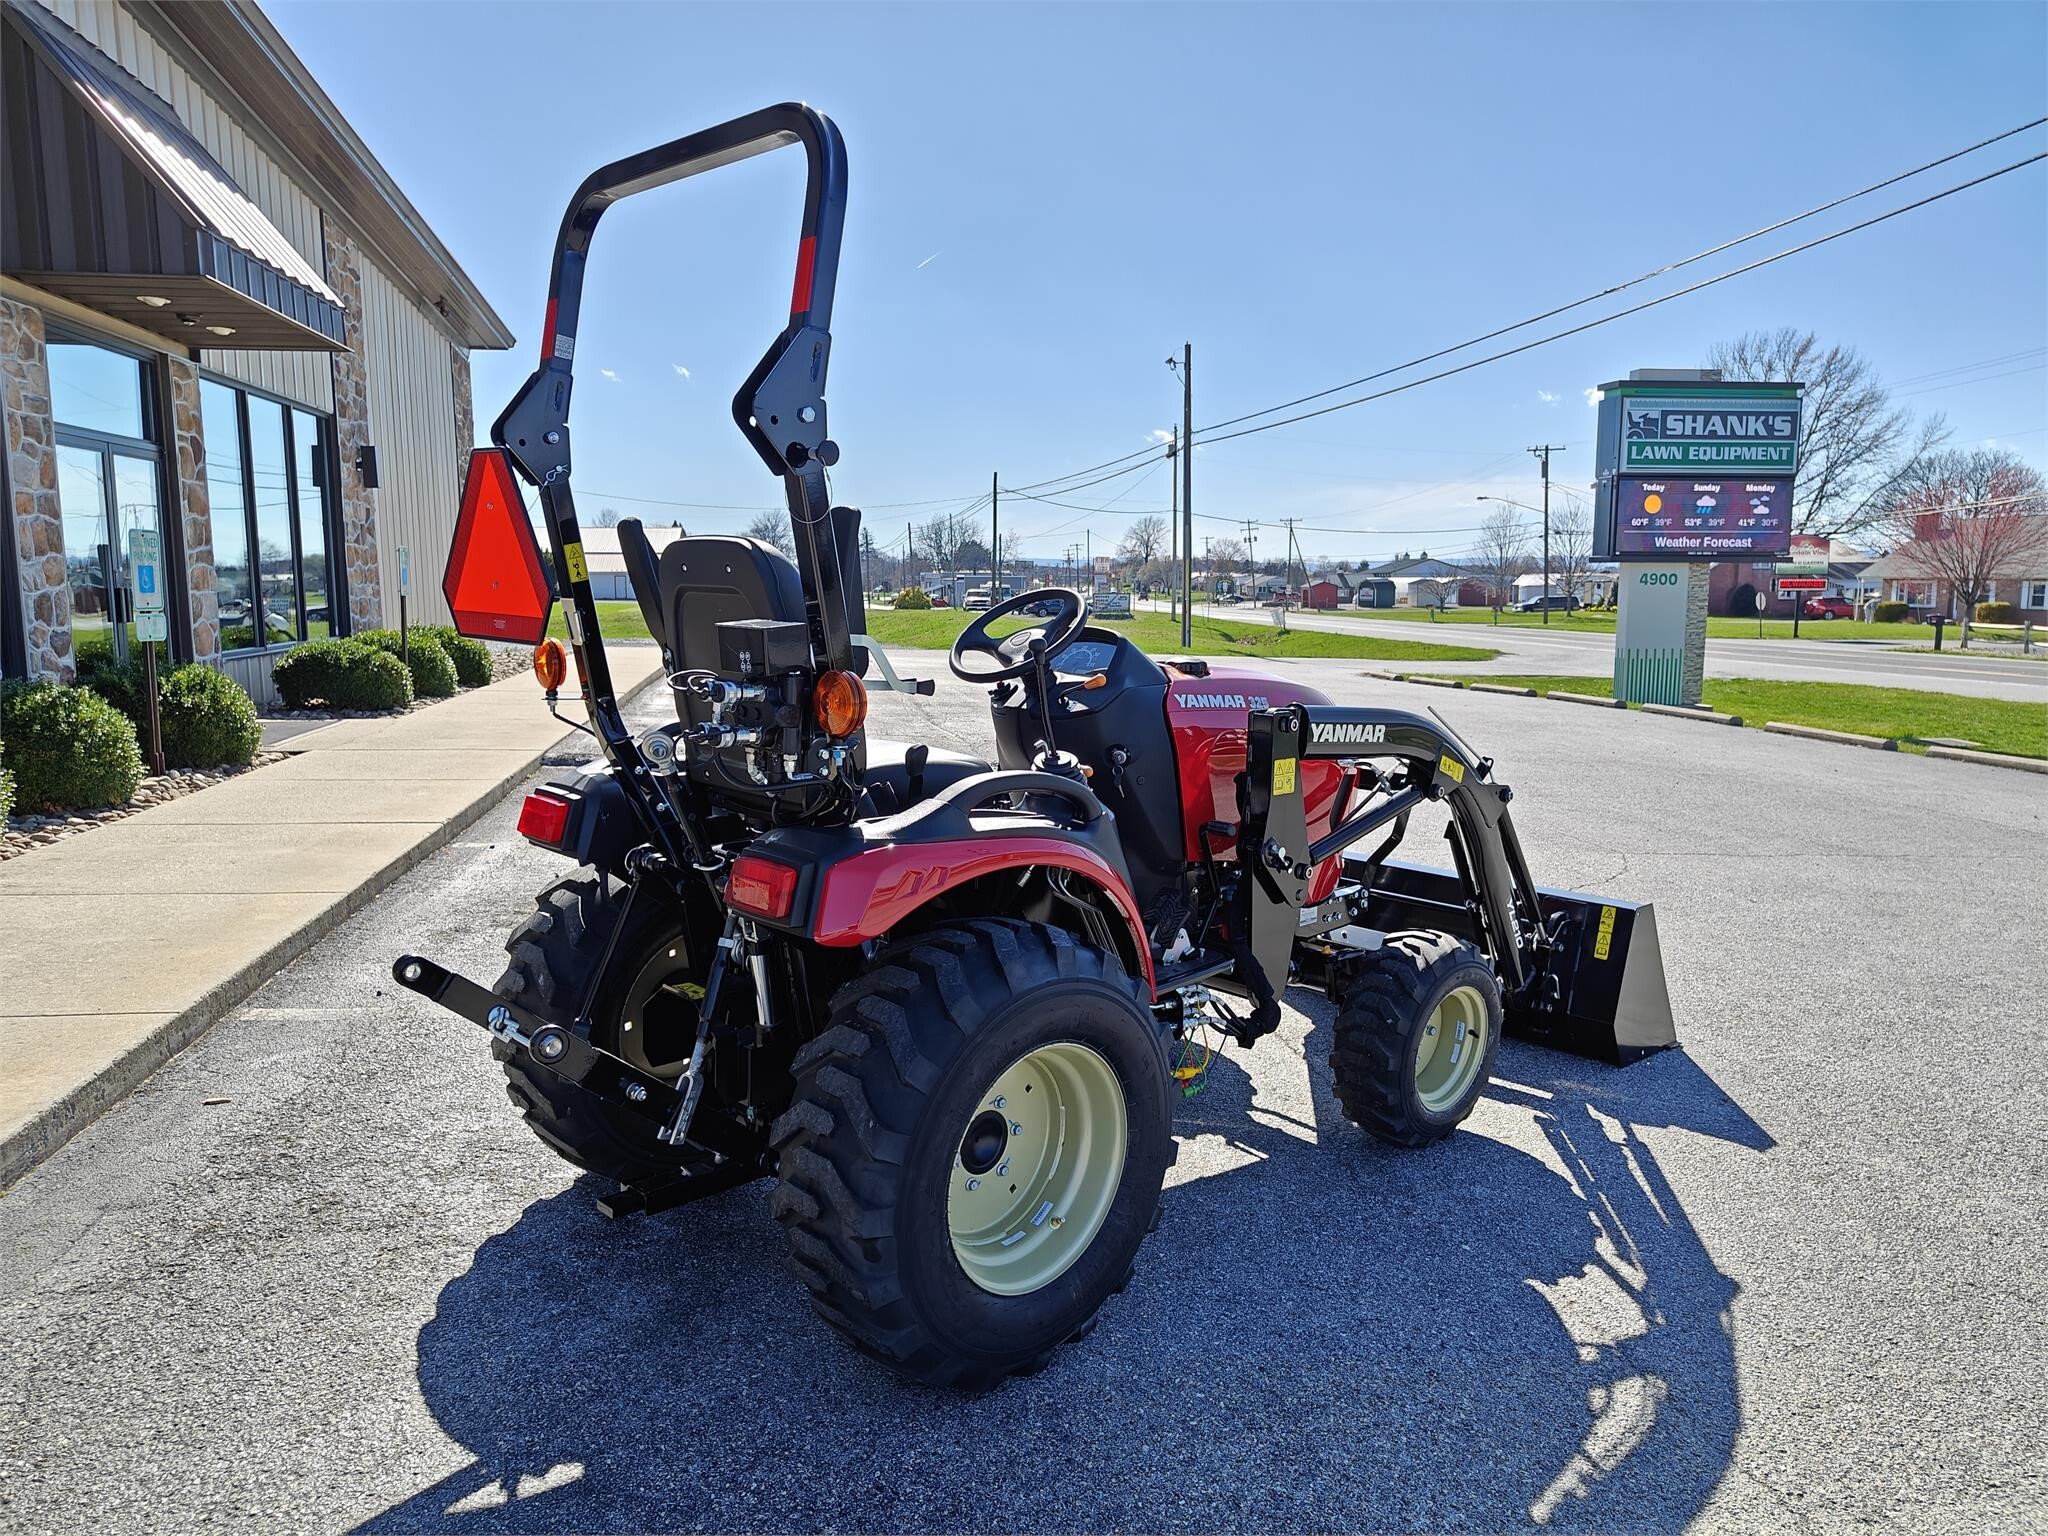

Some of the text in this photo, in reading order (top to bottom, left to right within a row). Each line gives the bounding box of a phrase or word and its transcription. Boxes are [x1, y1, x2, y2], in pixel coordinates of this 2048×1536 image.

[1666, 414, 1792, 436] SHANK'S
[1631, 445, 1791, 461] LAWN EQUIPMENT
[1642, 483, 1665, 492] Today
[1694, 484, 1720, 493] Sunday
[1746, 484, 1775, 493] Monday
[1655, 536, 1752, 548] Weather Forecast
[1639, 572, 1678, 586] 4900
[1174, 693, 1246, 708] YANMAR
[1311, 722, 1386, 743] YANMAR
[1506, 896, 1524, 949] YL210
